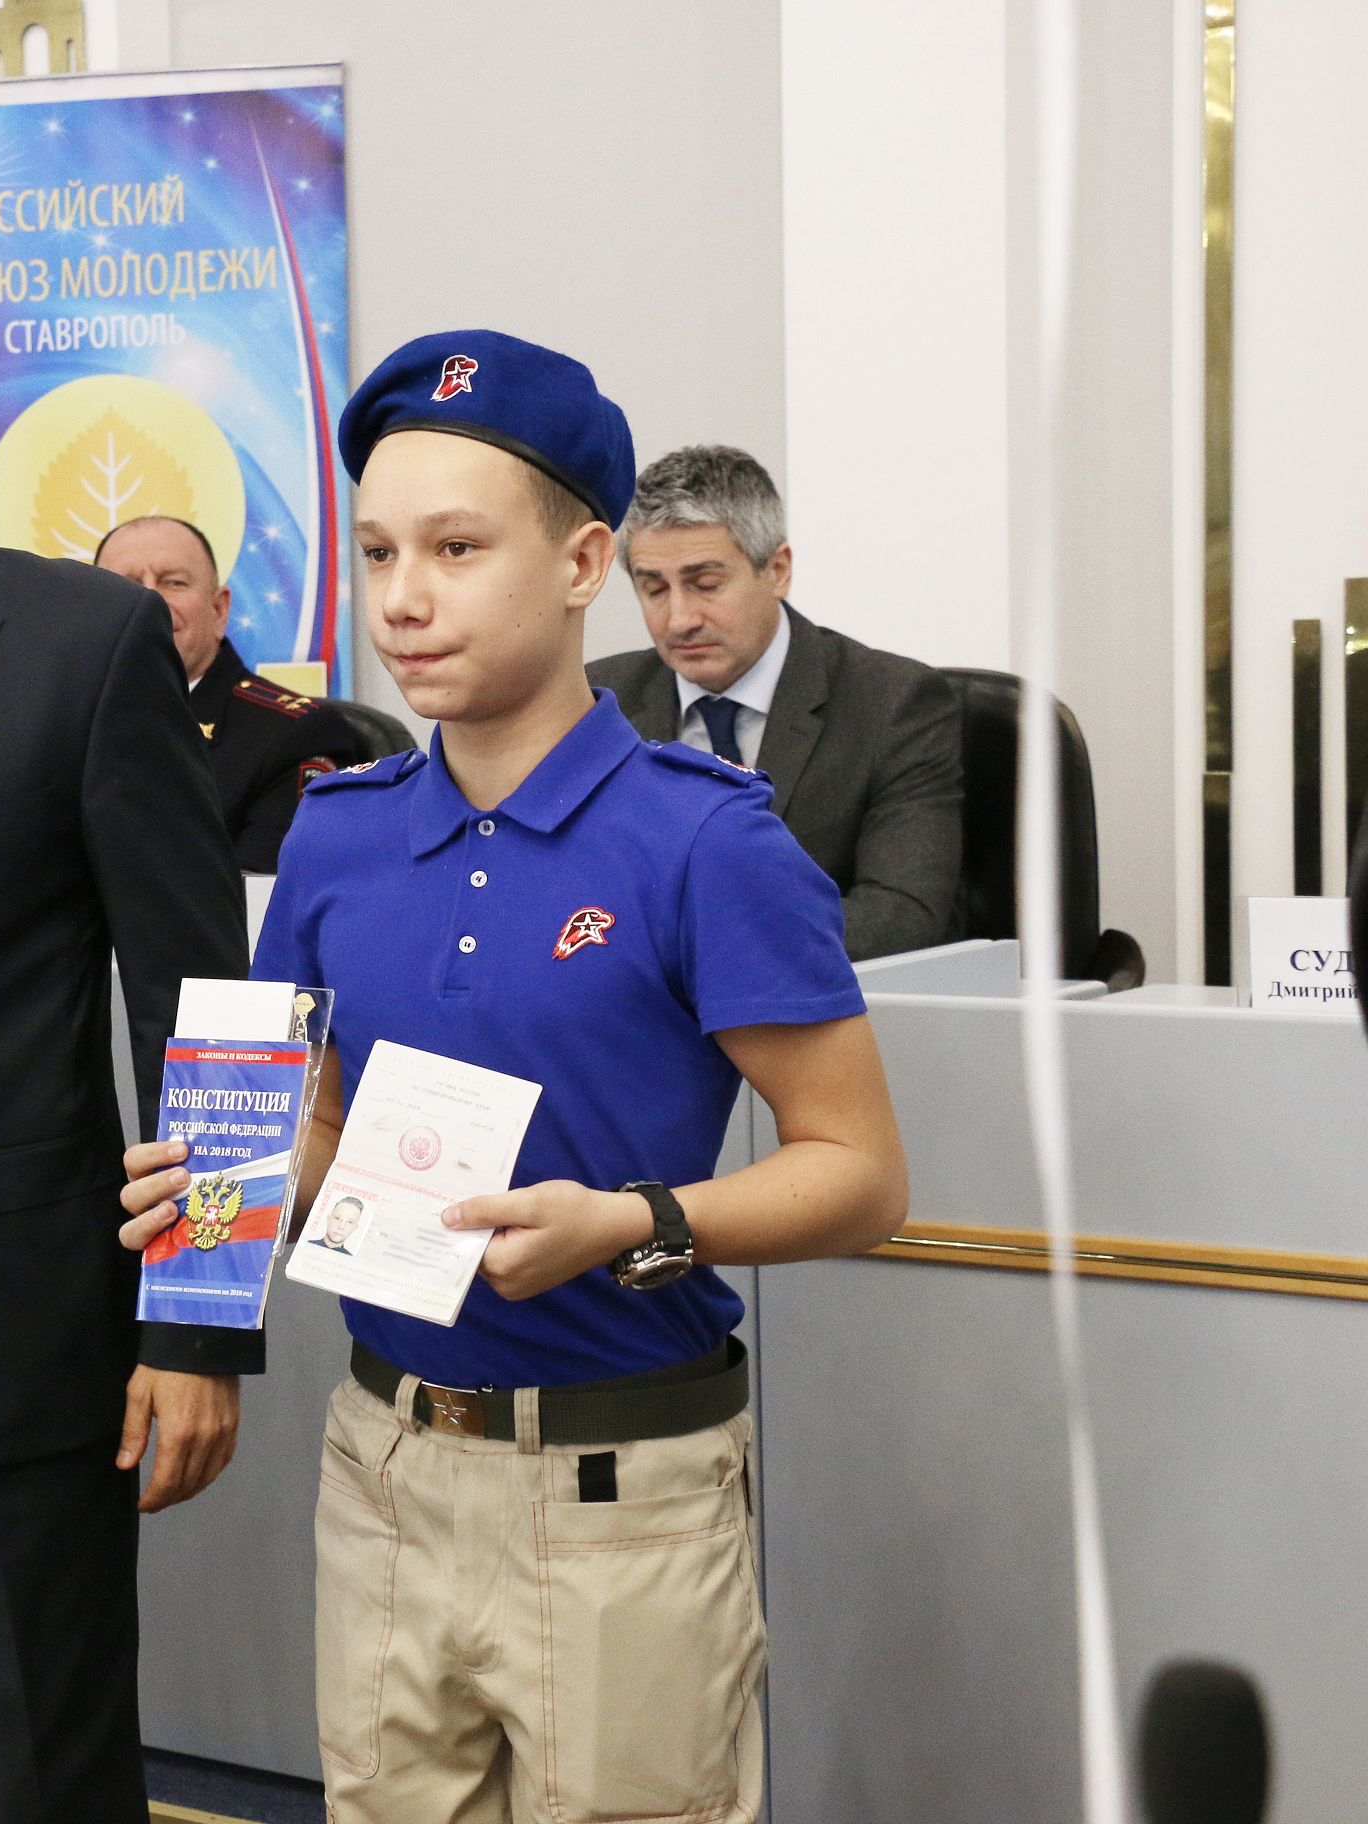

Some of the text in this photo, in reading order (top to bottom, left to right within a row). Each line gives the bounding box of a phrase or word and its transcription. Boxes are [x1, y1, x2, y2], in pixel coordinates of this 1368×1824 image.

[60, 246, 278, 301] МОЛОДЕЖИ
[4, 313, 186, 354] СТАВРОПОЛЬ
[1268, 981, 1359, 1002] Дмитрий
[196, 1051, 272, 1062] ЗАКОНЫ И КОДЕКСЫ
[166, 1087, 292, 1116] КОНСТИТУЦИЯ
[168, 1120, 282, 1138] РОССИЙСКОЙ ФЕДЕРАЦИИ
[194, 1146, 252, 1159] НА 2018 ГОД
[229, 1289, 243, 1297] 2018
